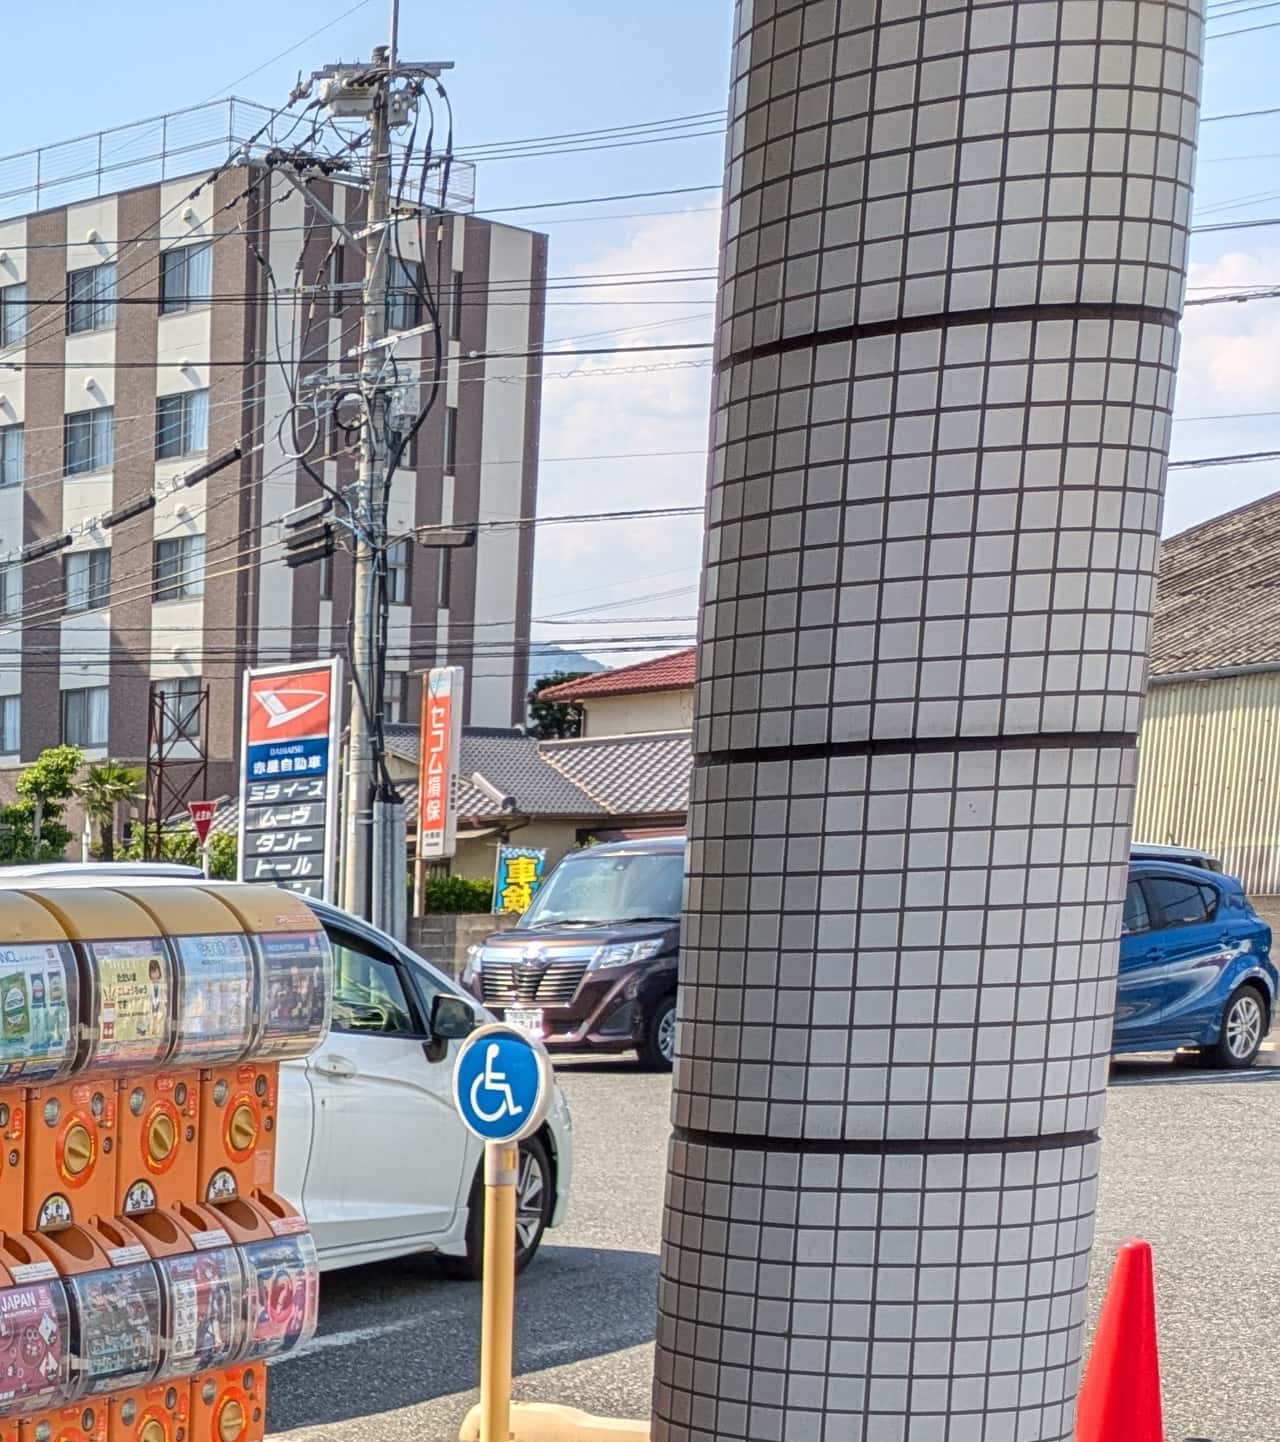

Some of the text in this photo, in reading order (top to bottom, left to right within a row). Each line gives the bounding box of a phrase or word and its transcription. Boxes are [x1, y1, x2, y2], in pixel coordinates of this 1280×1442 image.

[427, 707, 445, 823] セコム損保
[260, 806, 311, 827] ムーヴ
[256, 832, 313, 853] タント
[255, 856, 313, 877] トール
[1, 1292, 36, 1312] JAPAN
